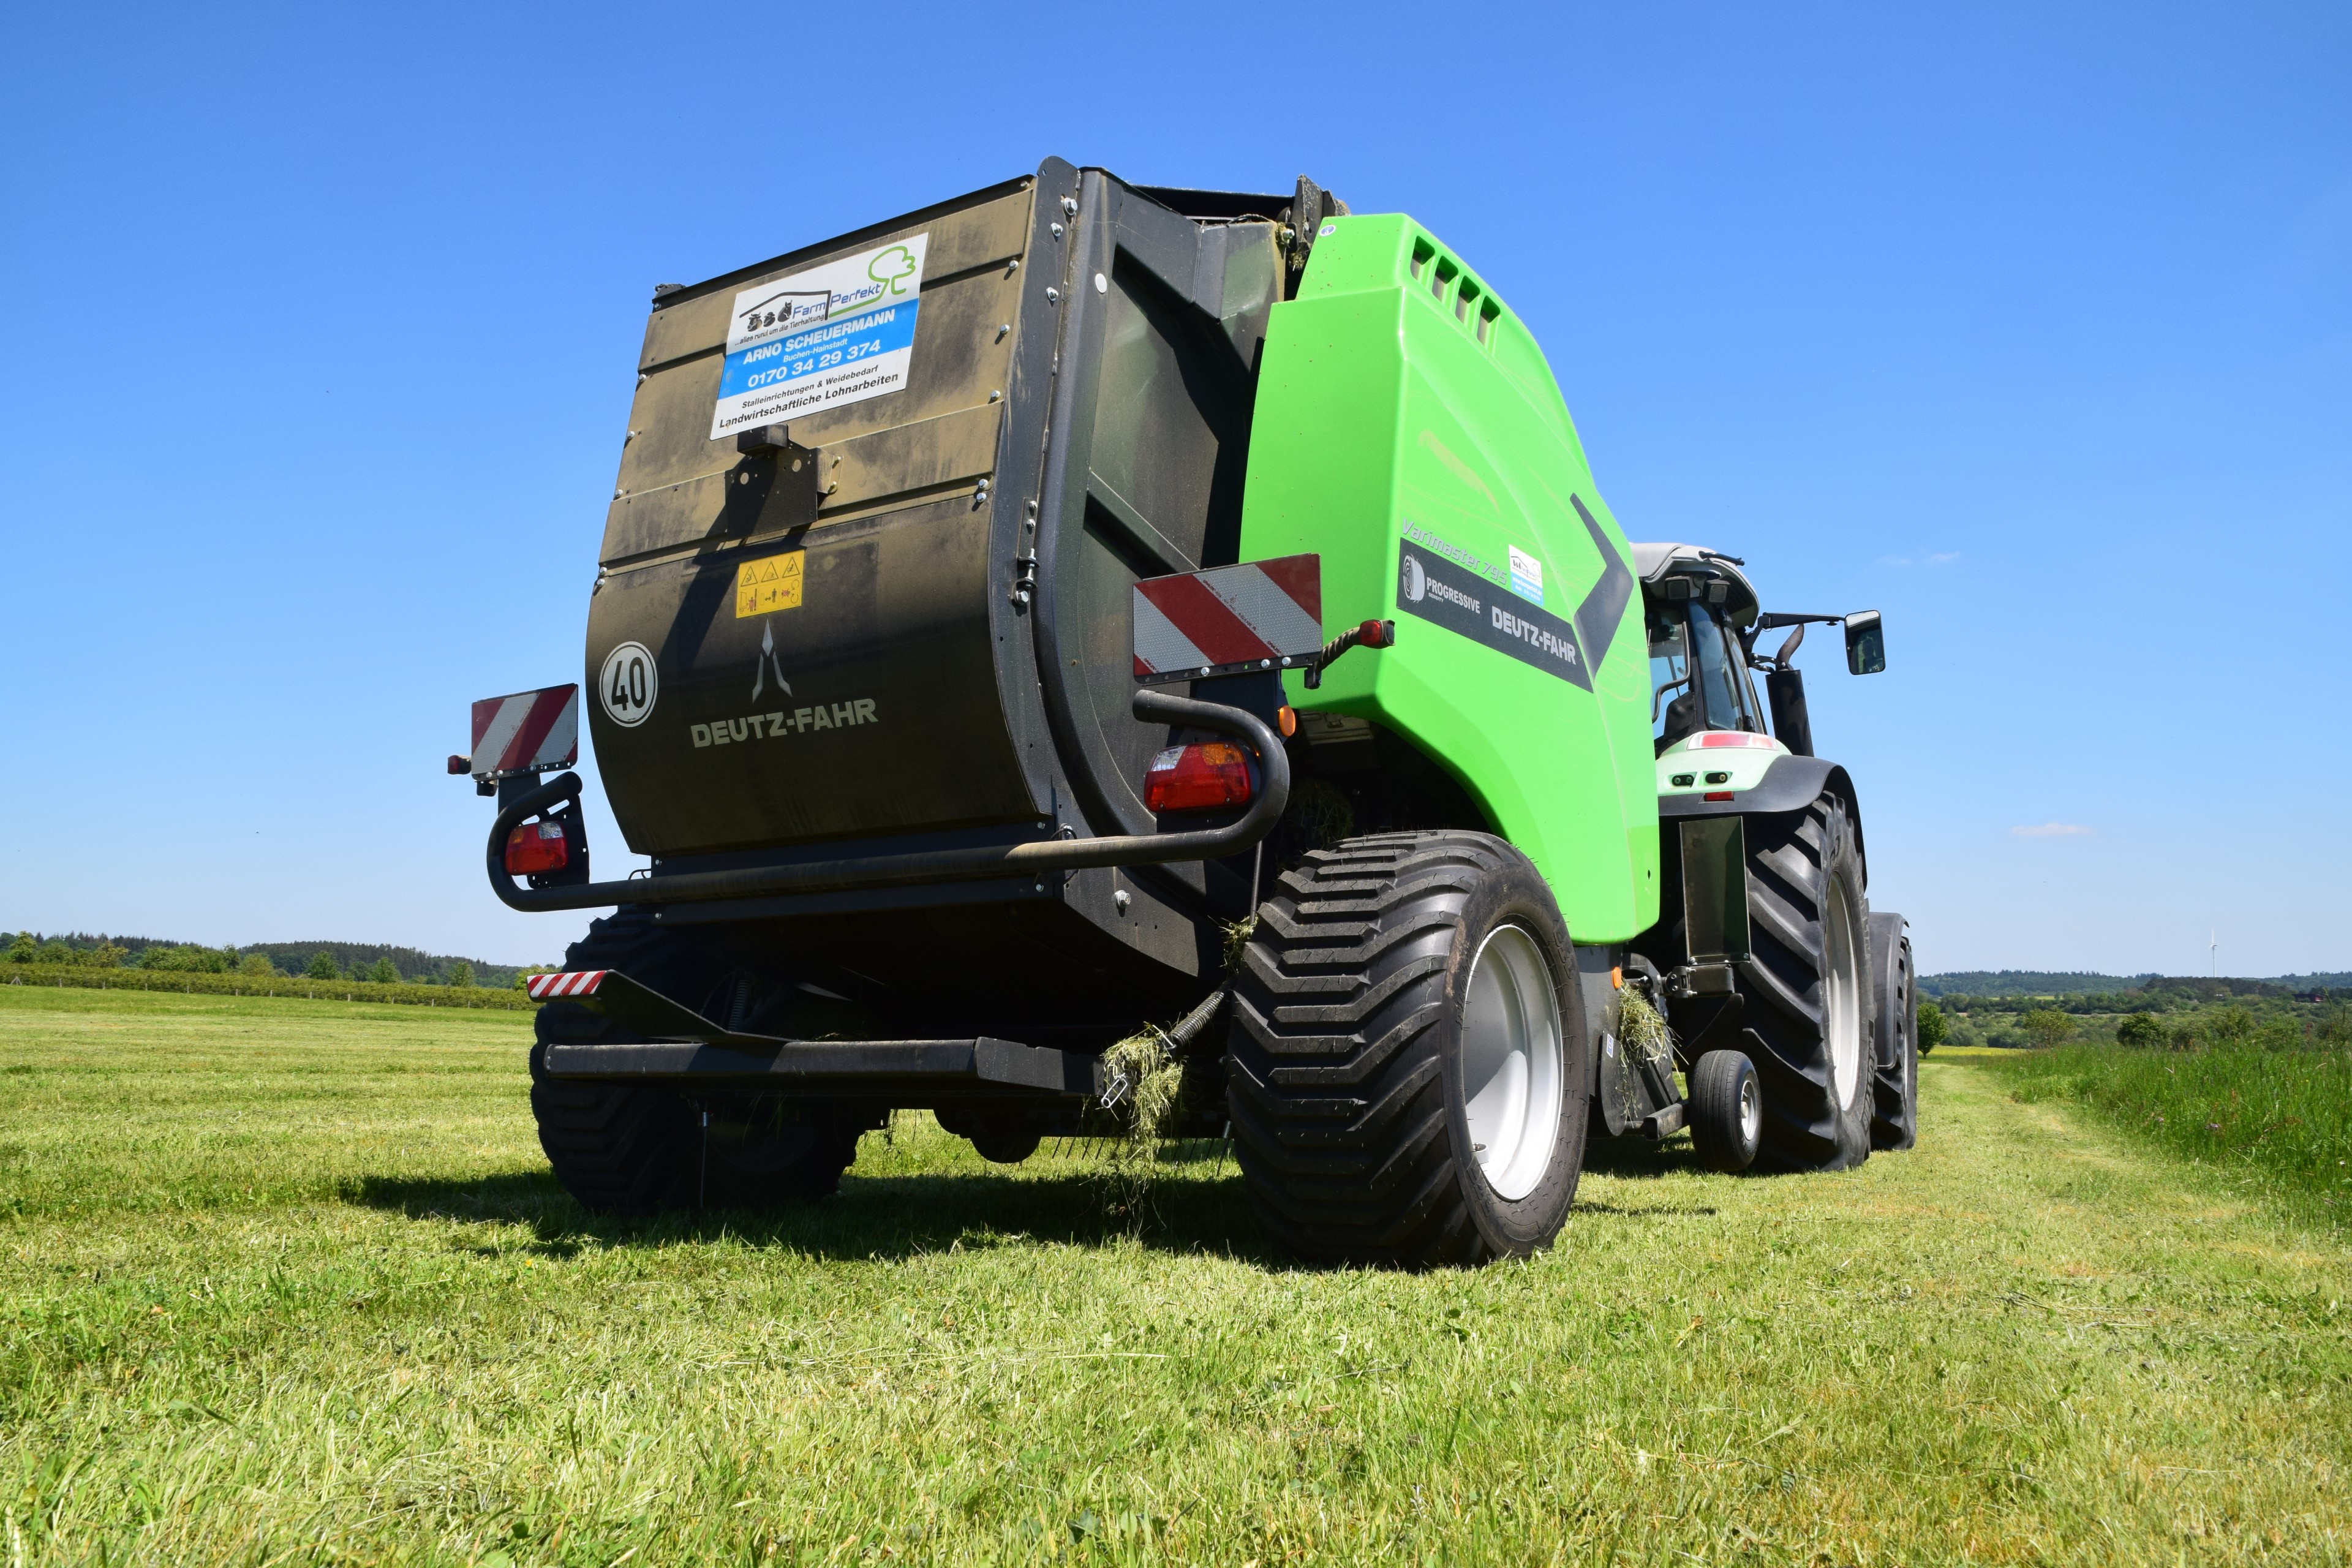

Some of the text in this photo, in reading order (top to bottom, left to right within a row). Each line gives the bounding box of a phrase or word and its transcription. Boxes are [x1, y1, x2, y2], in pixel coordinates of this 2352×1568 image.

[792, 283, 881, 319] Farm Perfekt
[743, 309, 895, 364] ARNO SCHEUERMANN
[755, 330, 768, 339] rund
[779, 322, 788, 332] die
[790, 314, 824, 329] Tierhaltung
[783, 338, 848, 363] Buchen-Hainstadt
[742, 364, 879, 409] Stalleinrichtungen & Weidebedarf
[748, 339, 881, 388] 0170 34 29 374
[719, 373, 899, 429] Landwirtschaftliche Lohnarbeiten
[1403, 517, 1507, 585] Varimaster 795
[1427, 576, 1480, 614] PROGRESSIVE
[1428, 592, 1444, 603] DENSITY
[1491, 605, 1577, 665] DEUTZ-FAHR
[611, 656, 646, 711] 40
[690, 698, 879, 748] DEUTZ-FAHR
